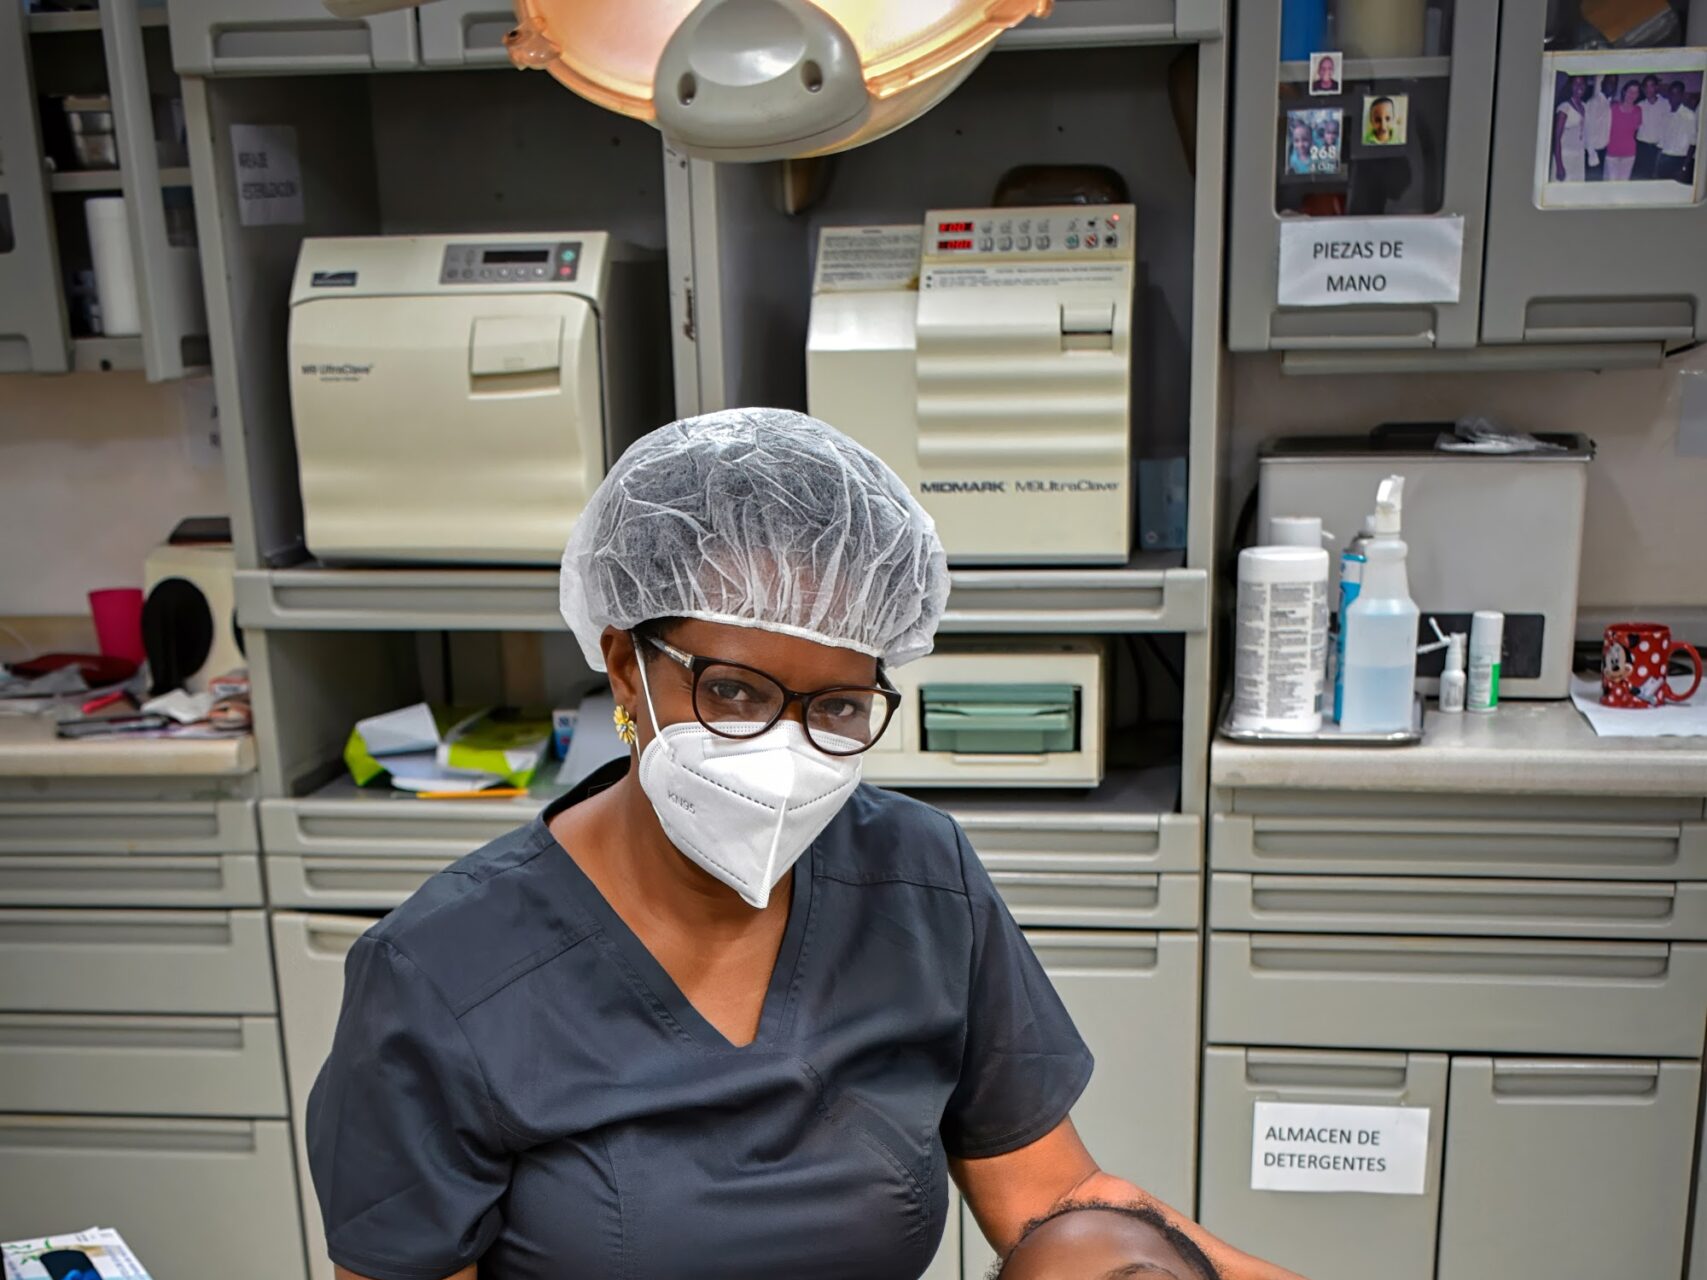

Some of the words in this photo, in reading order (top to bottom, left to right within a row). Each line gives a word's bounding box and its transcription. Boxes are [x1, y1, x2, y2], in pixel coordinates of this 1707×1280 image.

[1313, 241, 1374, 259] PIEZAS
[1380, 241, 1404, 258] DE
[1326, 274, 1387, 292] MANO
[920, 481, 1005, 494] MIDMARK
[1265, 1125, 1351, 1144] ALMACEN
[1358, 1130, 1381, 1146] DE
[1264, 1152, 1387, 1172] DETERGENTES
